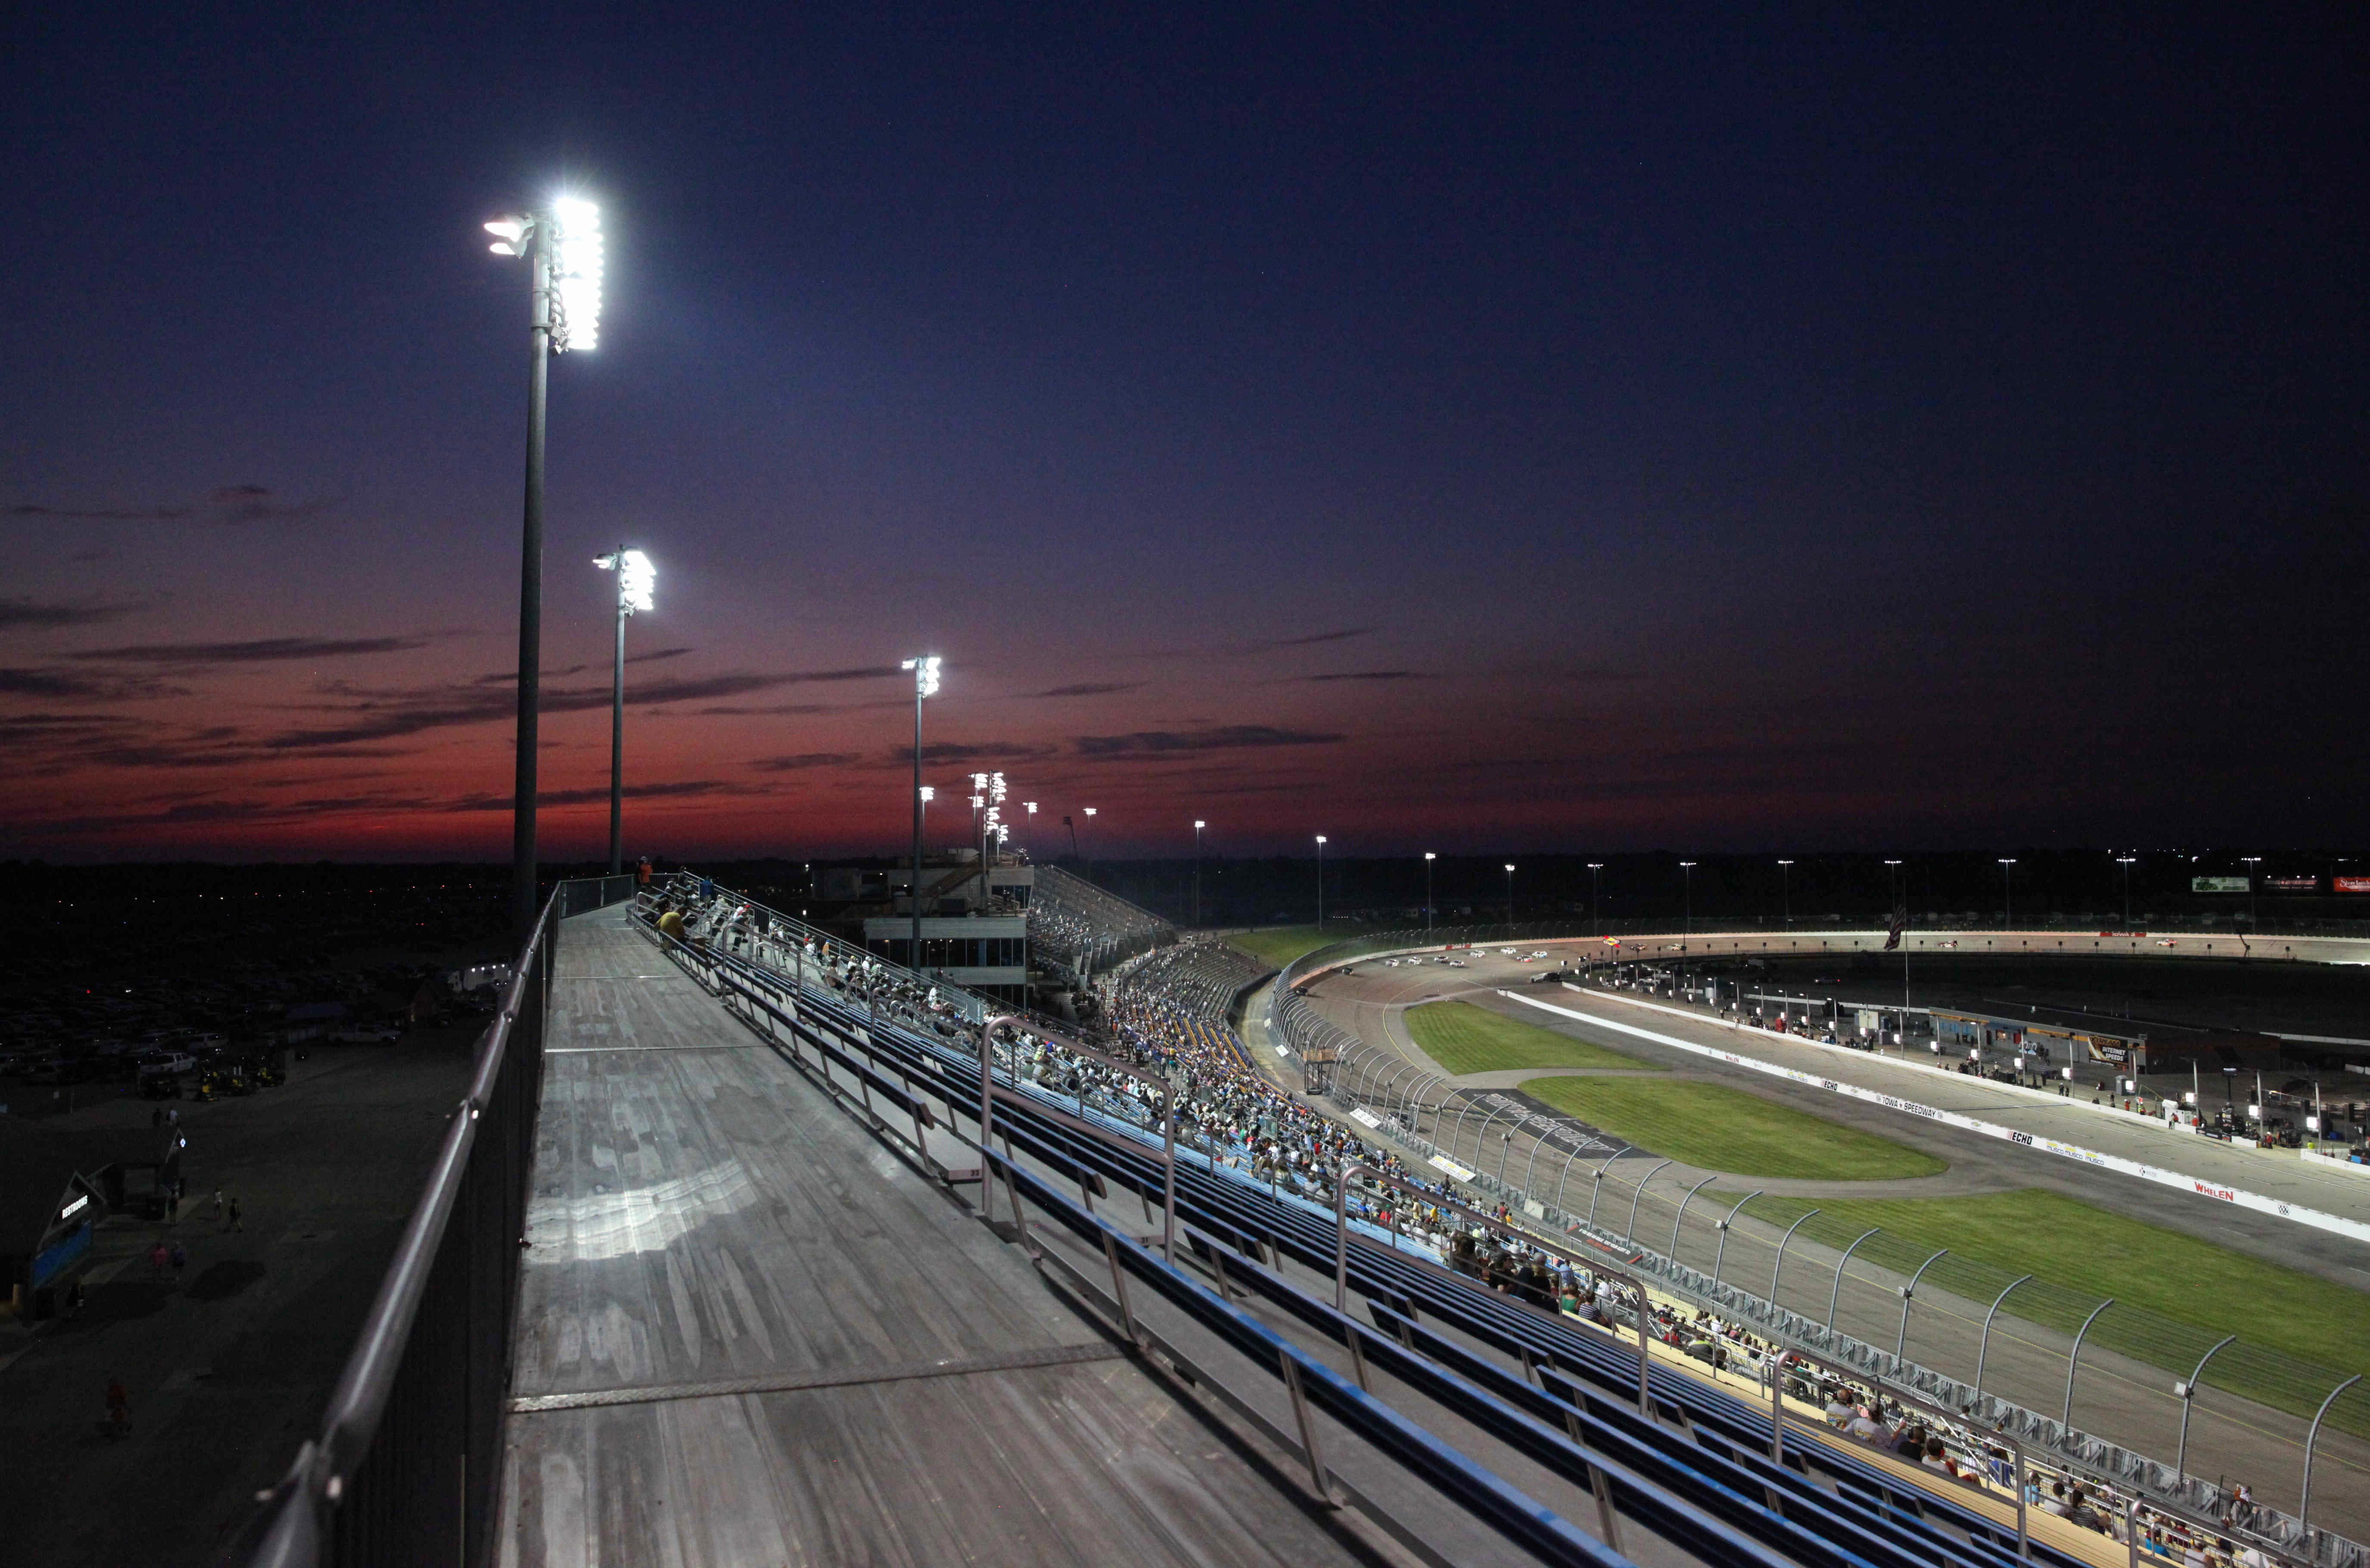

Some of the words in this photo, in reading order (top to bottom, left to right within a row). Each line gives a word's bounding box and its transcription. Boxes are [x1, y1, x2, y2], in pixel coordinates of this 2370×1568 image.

[2102, 1046, 2126, 1055] INTERNET
[2106, 1053, 2124, 1061] SPEEDS
[1824, 1081, 1838, 1091] ECHO
[1882, 1097, 1898, 1108] IOWA
[1904, 1103, 1936, 1118] SPEEDWAY
[2012, 1132, 2033, 1145] ECHO
[2194, 1181, 2233, 1201] WHELEN
[62, 1195, 88, 1219] RESTROOMS
